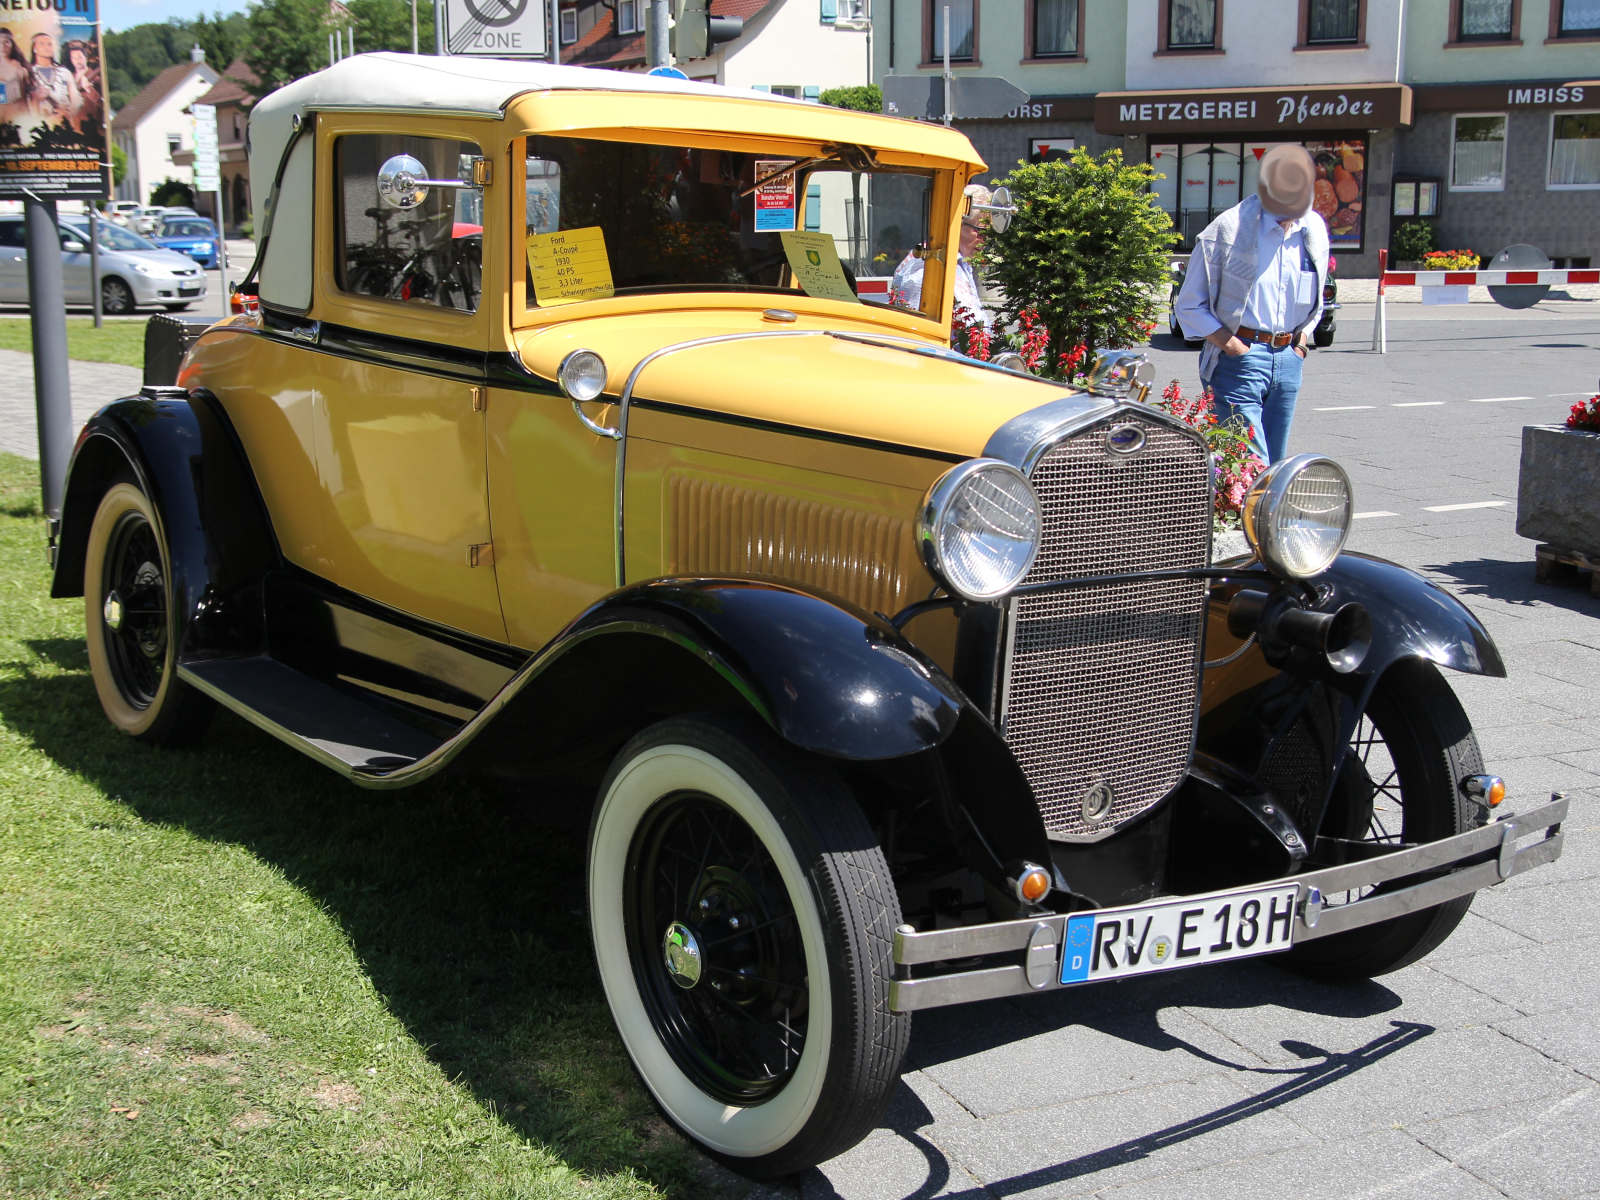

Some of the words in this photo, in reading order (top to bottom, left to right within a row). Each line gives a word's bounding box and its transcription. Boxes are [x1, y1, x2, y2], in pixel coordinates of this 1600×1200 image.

[473, 32, 522, 48] ZONE
[1507, 87, 1585, 105] IMBISS
[1119, 101, 1257, 121] METZGEREI
[1276, 94, 1374, 124] Pfender
[550, 236, 565, 244] Ford
[553, 244, 578, 255] A-Coupé
[555, 256, 570, 266] 1930
[566, 266, 574, 275] PS
[559, 279, 568, 288] 3,3
[570, 277, 584, 286] Liter
[1092, 916, 1153, 971] RV
[1072, 955, 1083, 970] D
